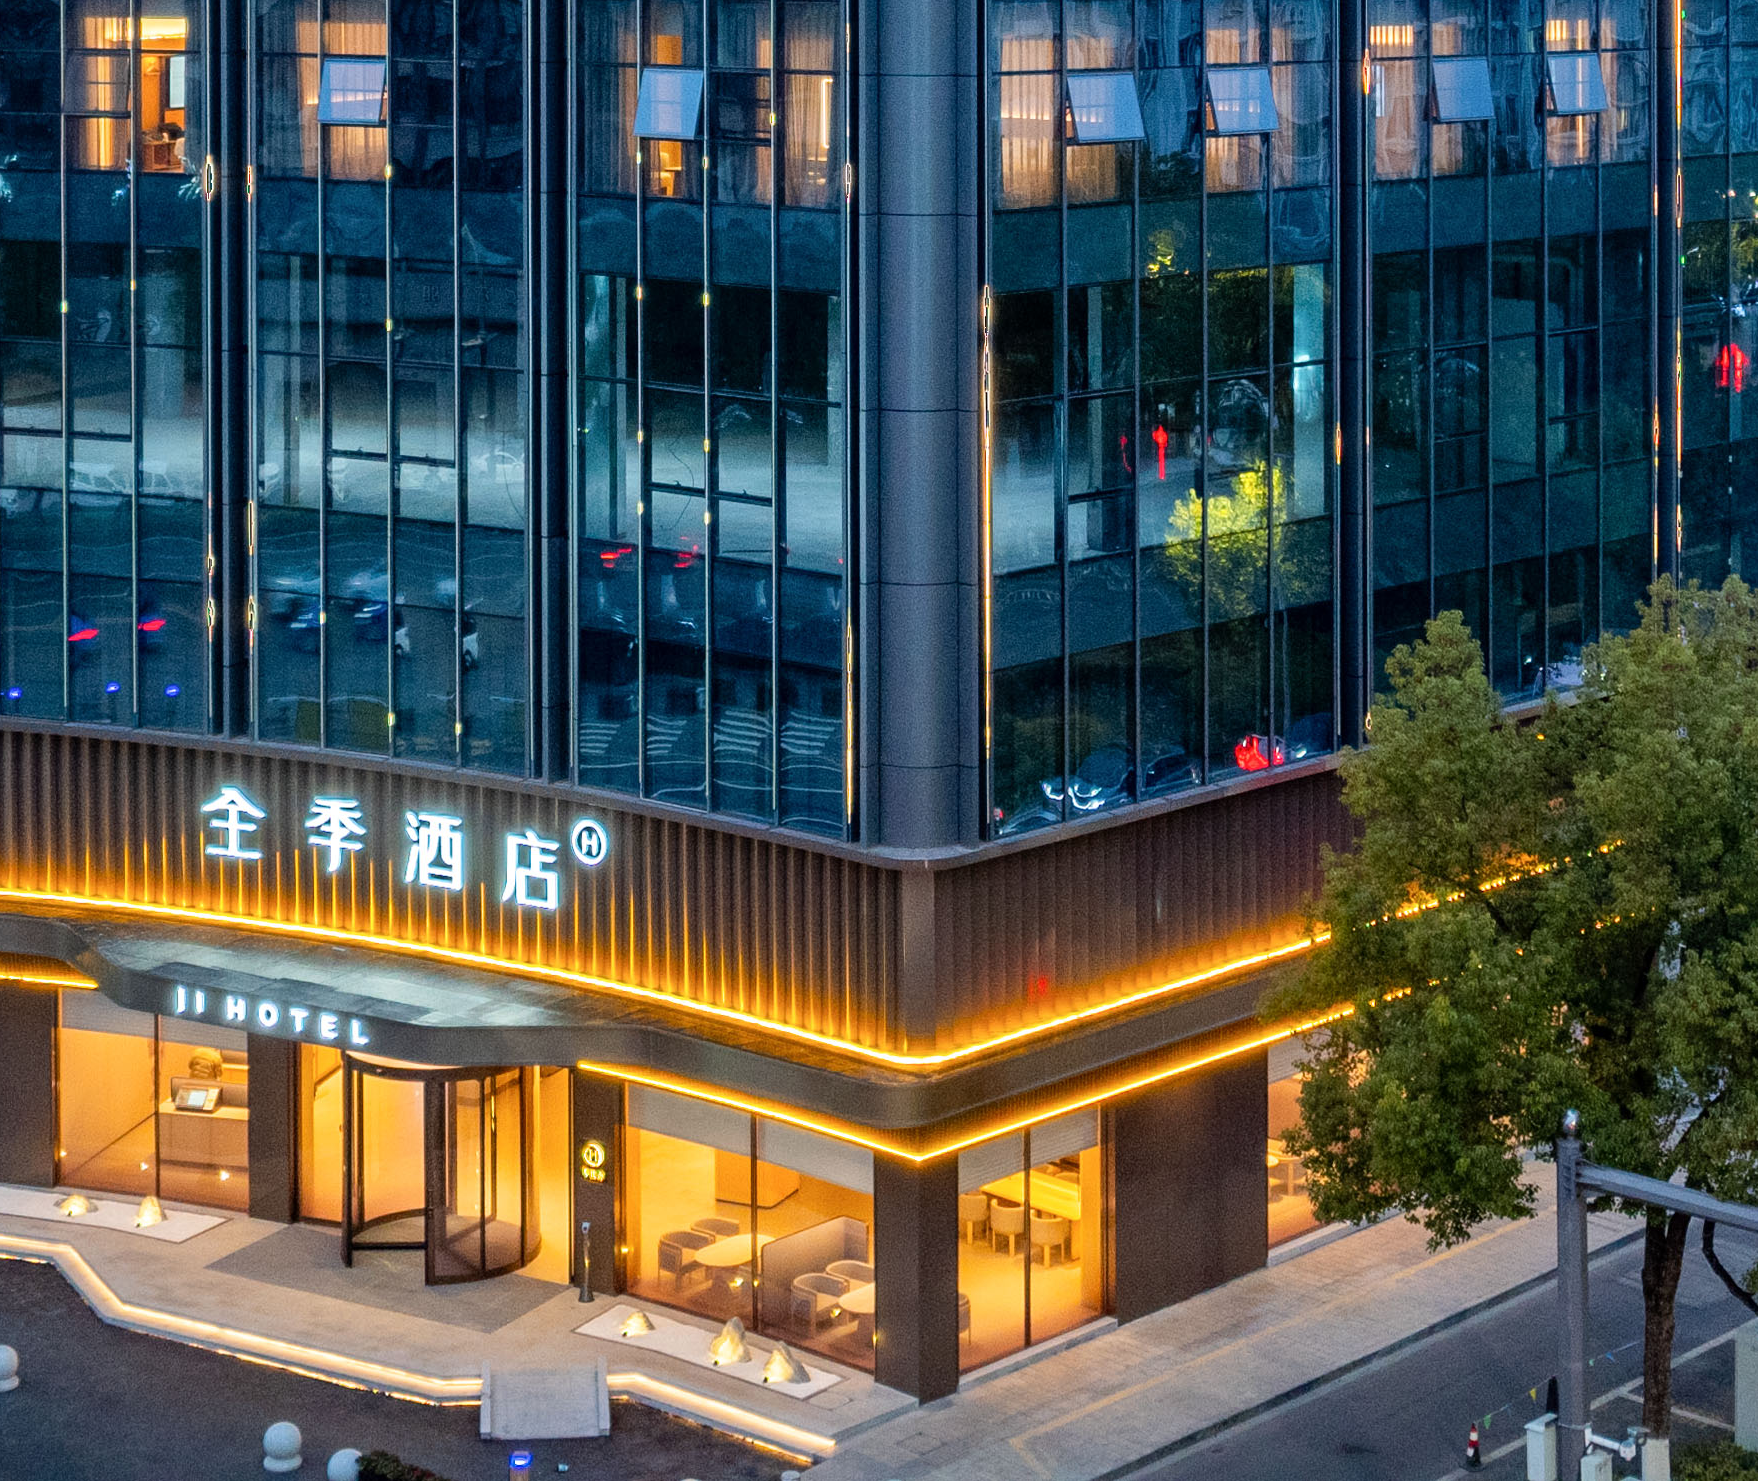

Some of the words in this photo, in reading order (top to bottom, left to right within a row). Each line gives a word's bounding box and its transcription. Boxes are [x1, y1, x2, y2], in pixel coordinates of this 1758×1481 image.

[200, 785, 561, 911] 全季酒店
[226, 995, 370, 1045] HOTEL
